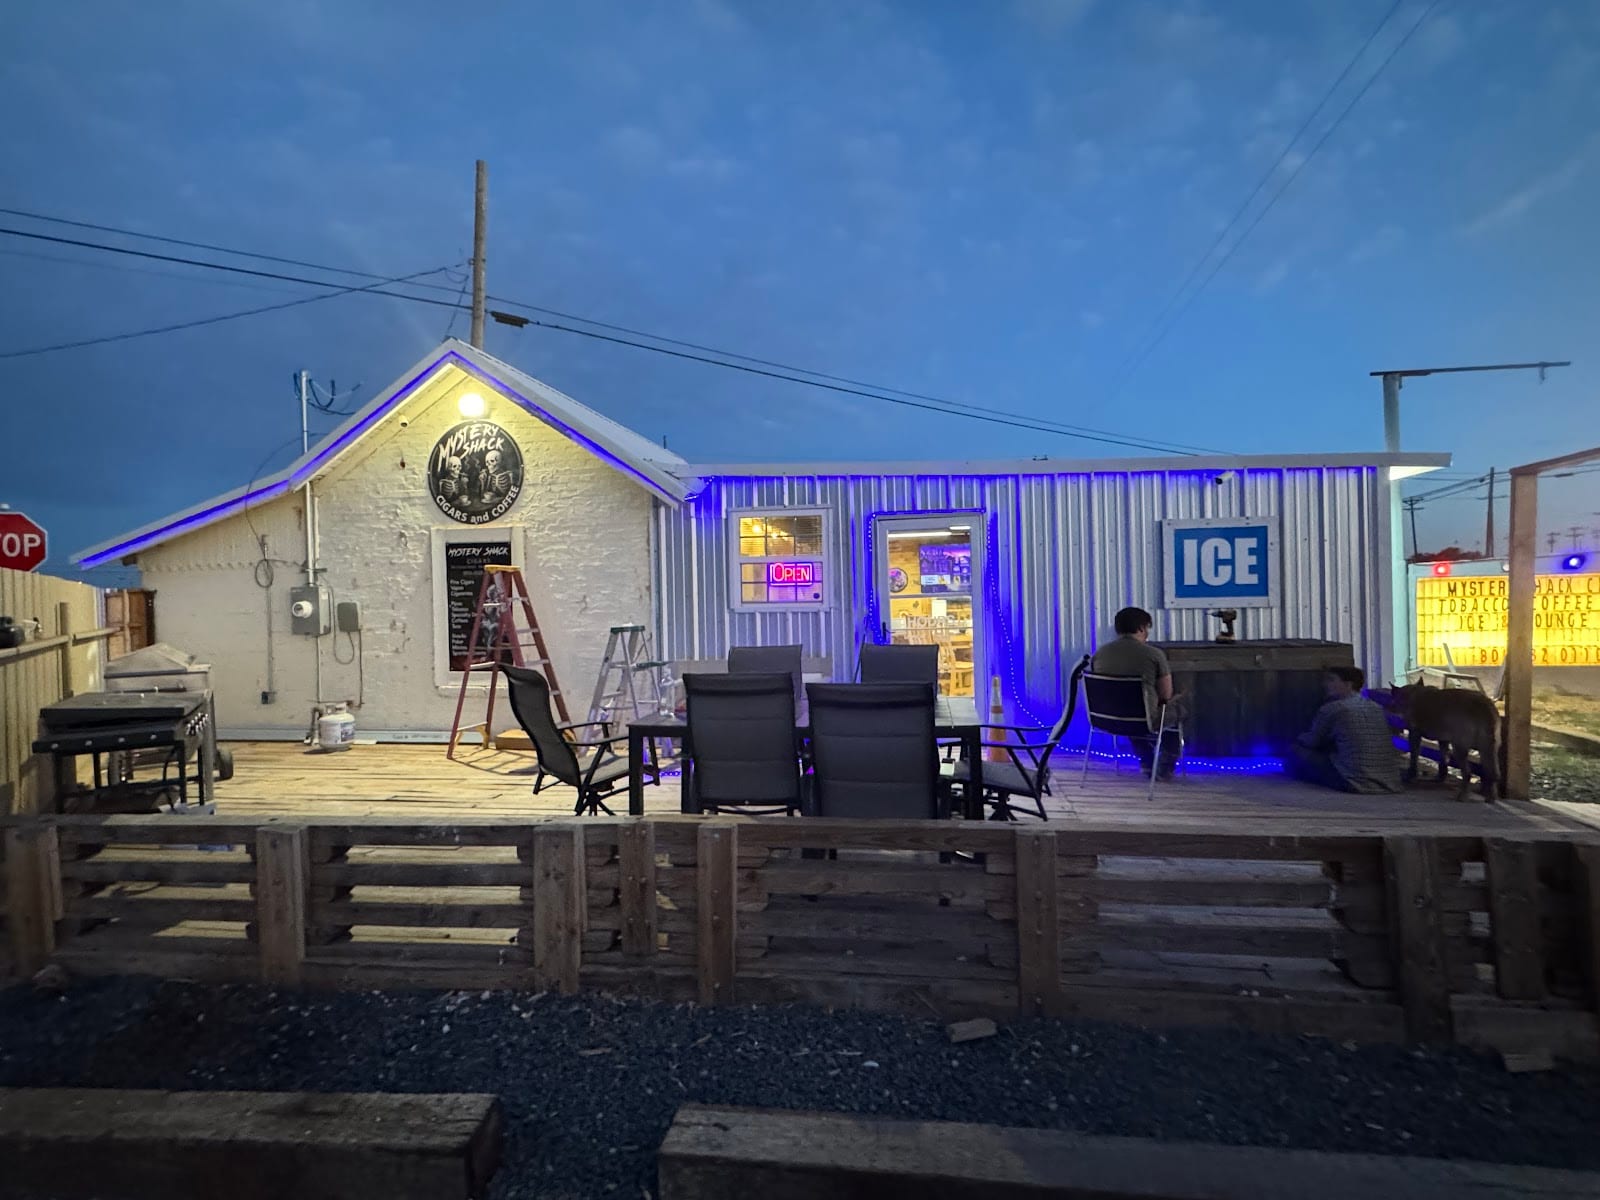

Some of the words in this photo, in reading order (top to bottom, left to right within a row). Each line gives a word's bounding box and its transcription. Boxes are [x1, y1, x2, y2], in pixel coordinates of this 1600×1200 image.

[437, 423, 500, 472] MYSTERY
[459, 438, 504, 459] SHACK
[436, 495, 468, 522] CIGARS
[470, 511, 490, 524] and
[491, 485, 519, 516] COFFEE
[0, 533, 41, 557] OP
[448, 547, 482, 557] MYSTERY
[483, 546, 509, 556] SHACK
[1183, 537, 1259, 586] ICE
[773, 563, 810, 582] OPEN
[1447, 580, 1506, 596] MYSTER
[1532, 594, 1592, 612] OFFEE
[1460, 614, 1485, 632] ICE
[1535, 612, 1587, 629] OUNGE
